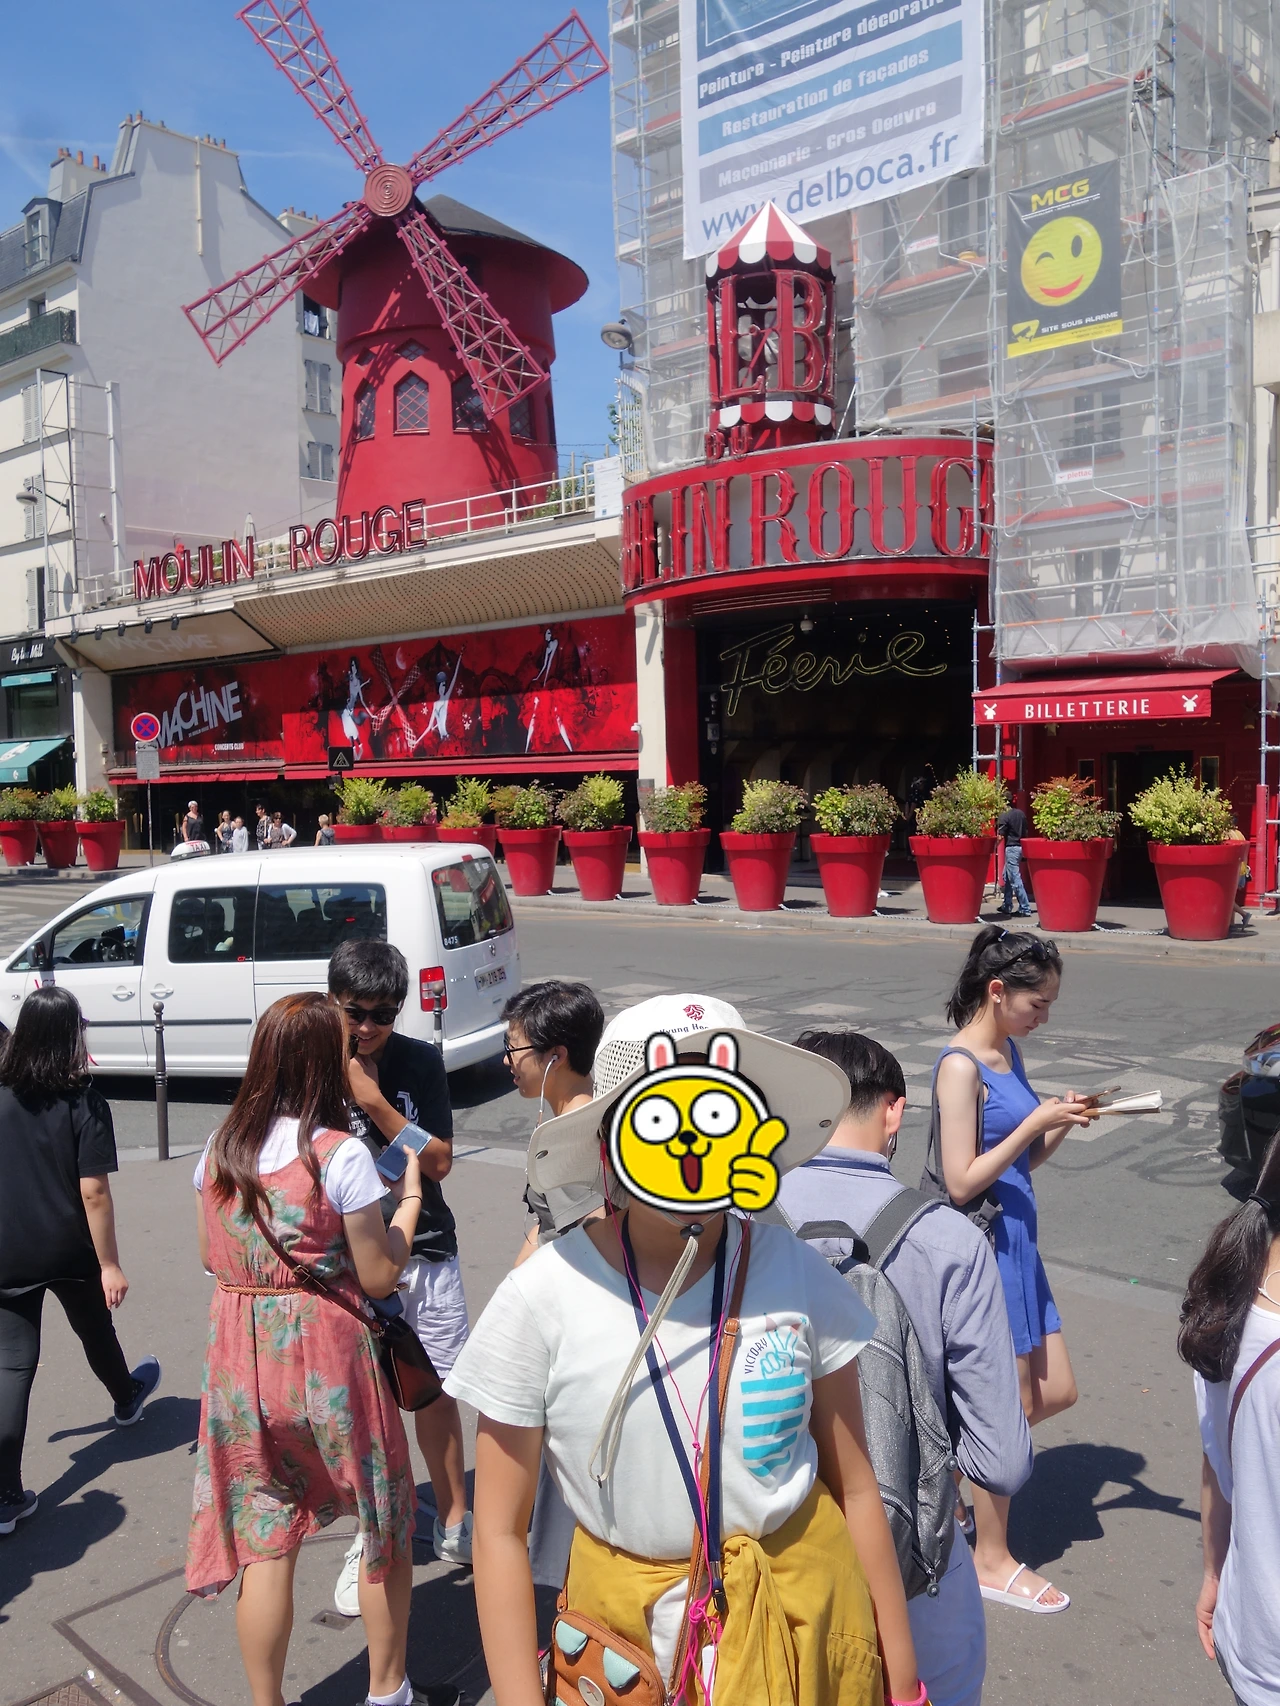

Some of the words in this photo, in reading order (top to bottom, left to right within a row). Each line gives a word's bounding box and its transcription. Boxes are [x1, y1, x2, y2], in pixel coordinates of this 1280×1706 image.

[699, 60, 764, 99] Peinture
[781, 26, 852, 68] Peinture
[857, 0, 943, 34] décorat
[722, 85, 828, 137] Restauration
[832, 77, 852, 98] de
[857, 48, 929, 84] façades
[718, 144, 811, 188] Maçonnerie
[826, 126, 866, 150] Gros
[872, 101, 937, 136] Oeuvre
[701, 131, 958, 241] wwdelboca.fr
[1031, 178, 1090, 213] MCG
[1041, 324, 1059, 334] SITE
[1061, 318, 1083, 329] SOUS
[1085, 311, 1119, 324] ALARME
[133, 535, 255, 601] MOULIN
[288, 497, 426, 571] ROUGE
[720, 622, 948, 717] Féerie
[1025, 698, 1150, 719] BILLETTERIE
[157, 681, 243, 750] MACHINE
[444, 935, 458, 946] 8475
[745, 1337, 768, 1375] VICTORY
